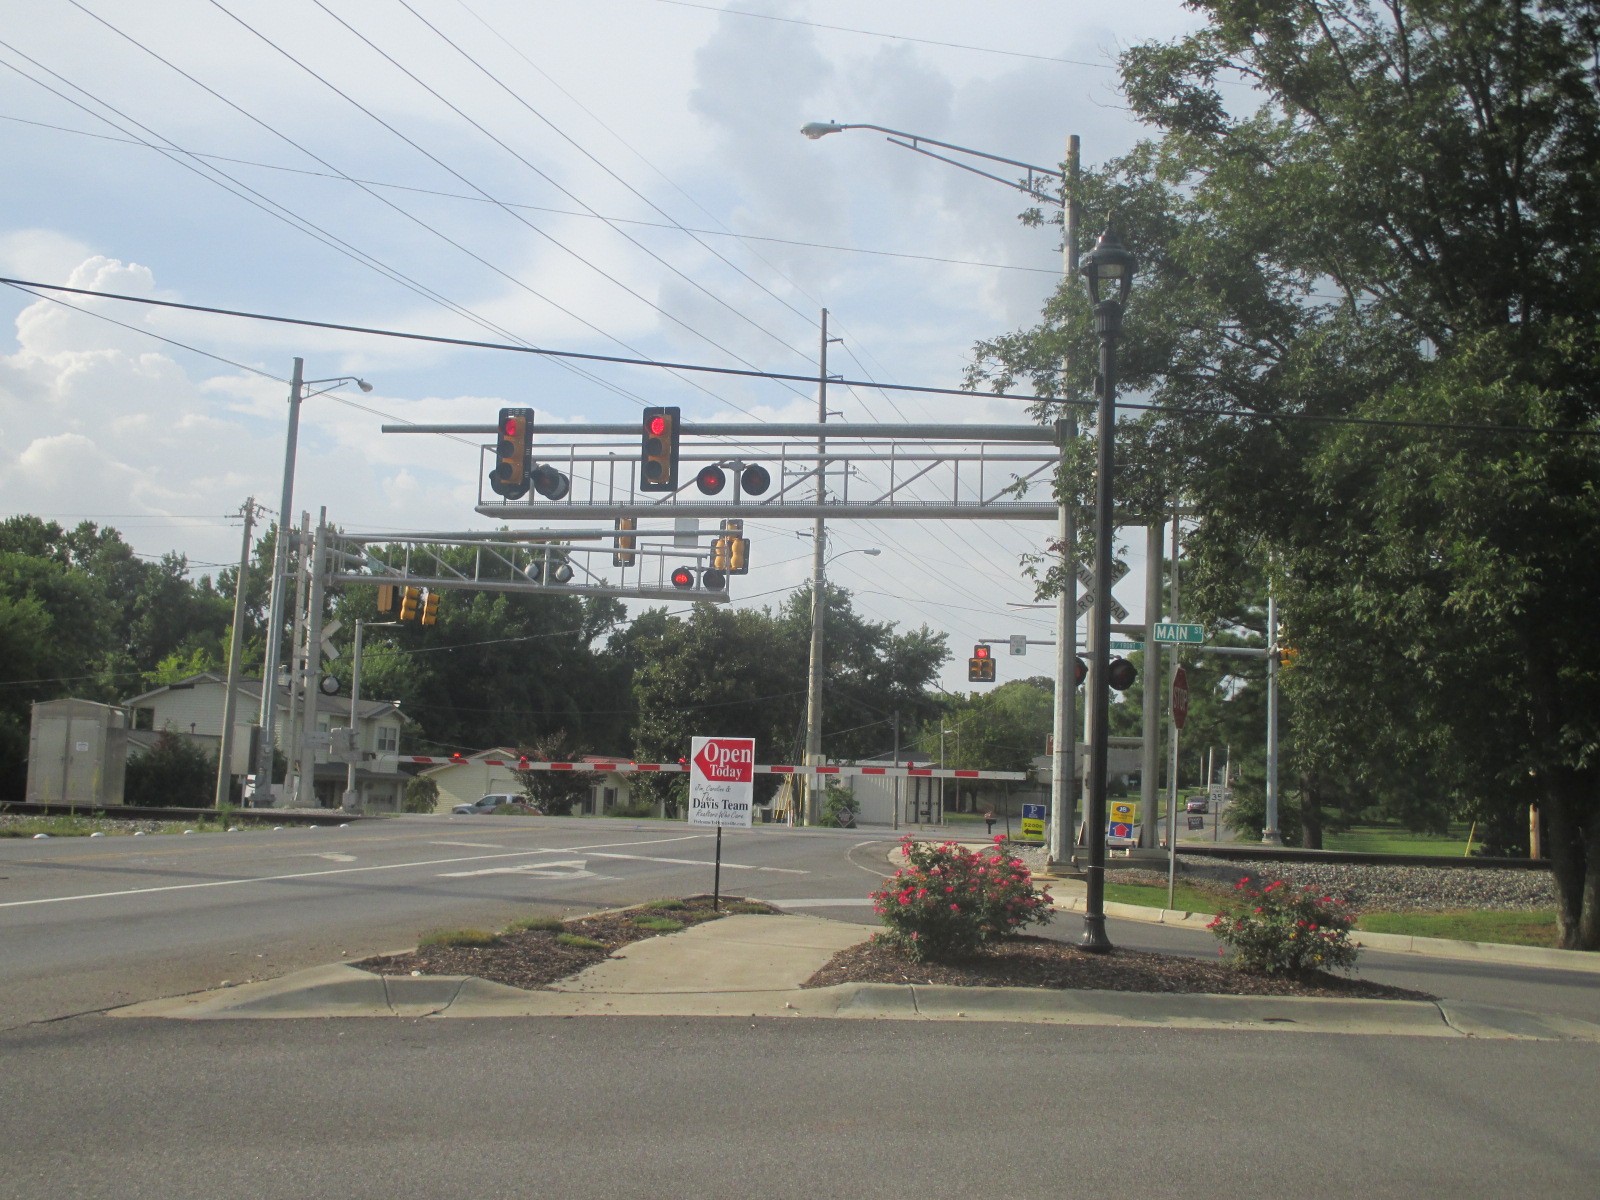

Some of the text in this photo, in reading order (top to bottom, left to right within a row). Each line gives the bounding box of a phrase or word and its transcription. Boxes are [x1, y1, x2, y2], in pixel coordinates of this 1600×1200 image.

[1156, 625, 1188, 640] MAIN
[1173, 686, 1188, 711] STOP
[703, 742, 752, 767] Open
[709, 764, 743, 780] Today
[692, 797, 749, 811] Davis Team
[1211, 793, 1222, 801] 35
